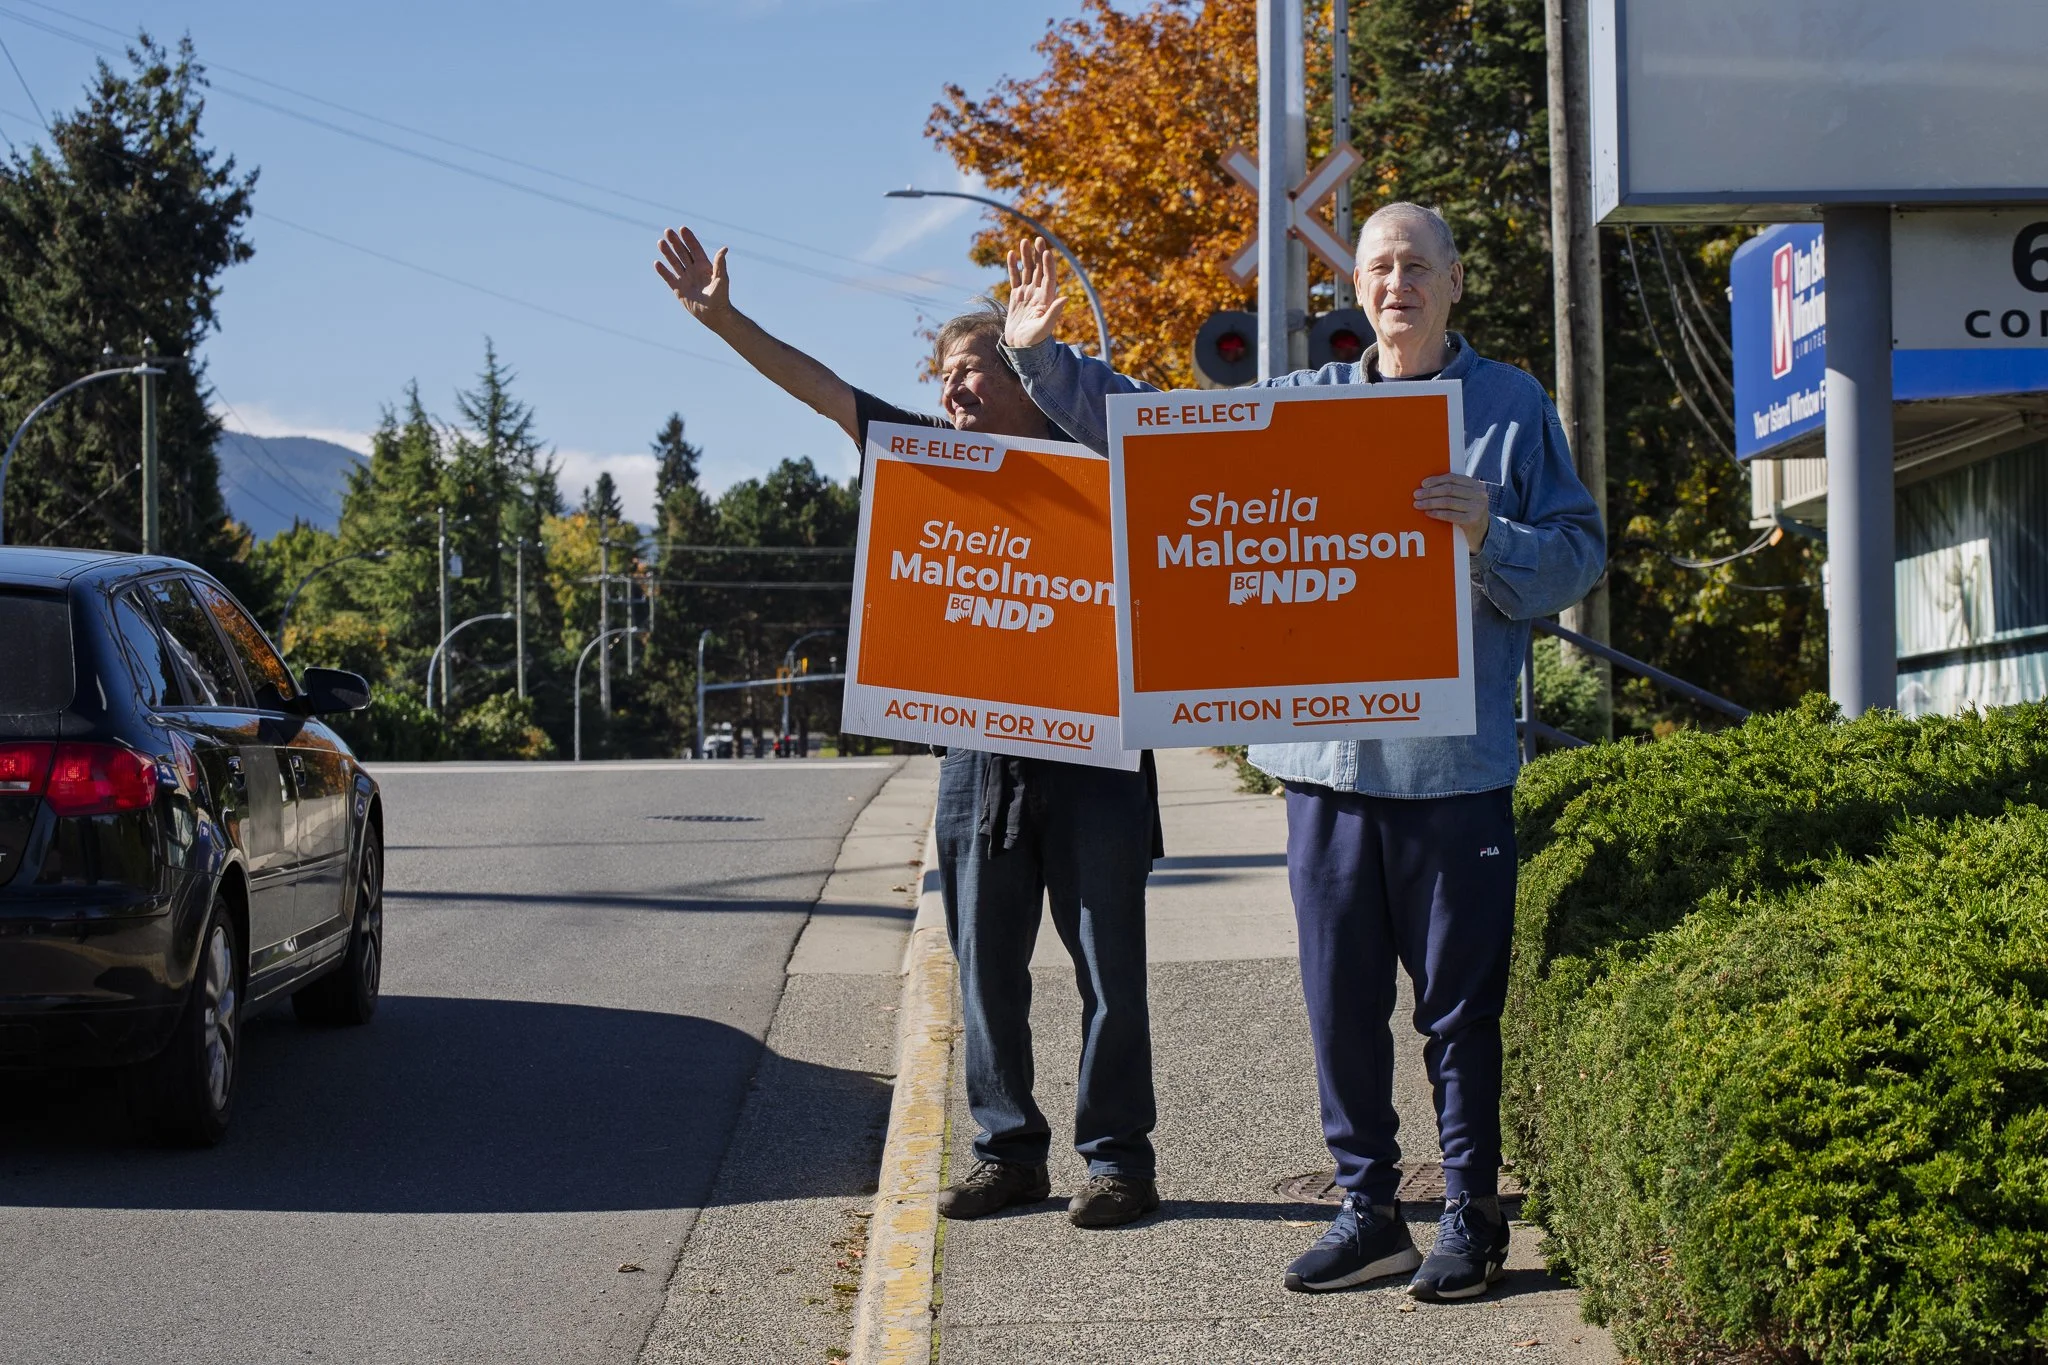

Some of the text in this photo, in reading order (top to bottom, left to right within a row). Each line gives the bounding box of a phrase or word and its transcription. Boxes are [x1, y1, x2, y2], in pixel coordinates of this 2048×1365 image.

[1964, 309, 2048, 339] CO
[1137, 402, 1261, 427] RE-ELECT
[891, 436, 995, 464] RE-ELECT
[1186, 488, 1319, 527] Sheila
[919, 520, 1032, 560] Sheila
[1157, 527, 1426, 569] Malcolmson
[890, 550, 1116, 607] Malcolmson
[1261, 567, 1357, 605] NDP
[971, 597, 1055, 633] NDP
[884, 699, 1096, 743] ACTION FOR YOU
[1172, 692, 1421, 725] ACTION FOR YOU
[1480, 846, 1500, 857] FILA
